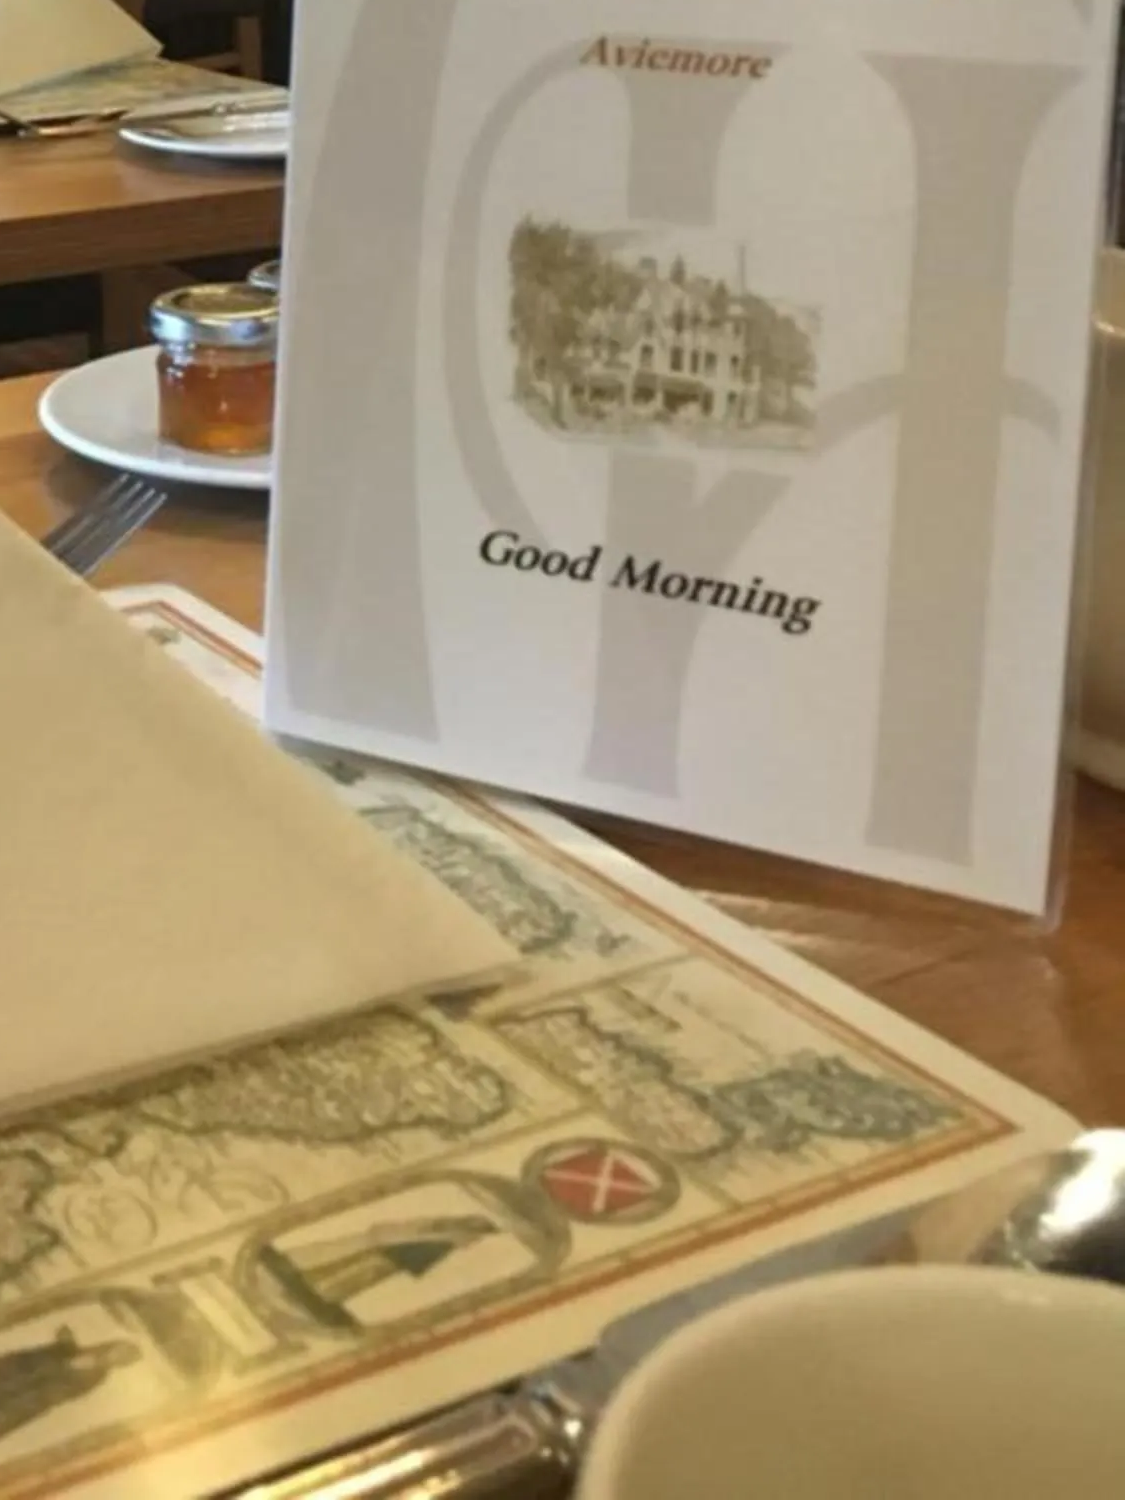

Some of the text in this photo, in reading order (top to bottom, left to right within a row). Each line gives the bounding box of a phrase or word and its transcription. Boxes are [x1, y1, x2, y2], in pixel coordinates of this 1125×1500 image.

[578, 36, 773, 80] Aviemore
[478, 528, 823, 636] Good Morning
